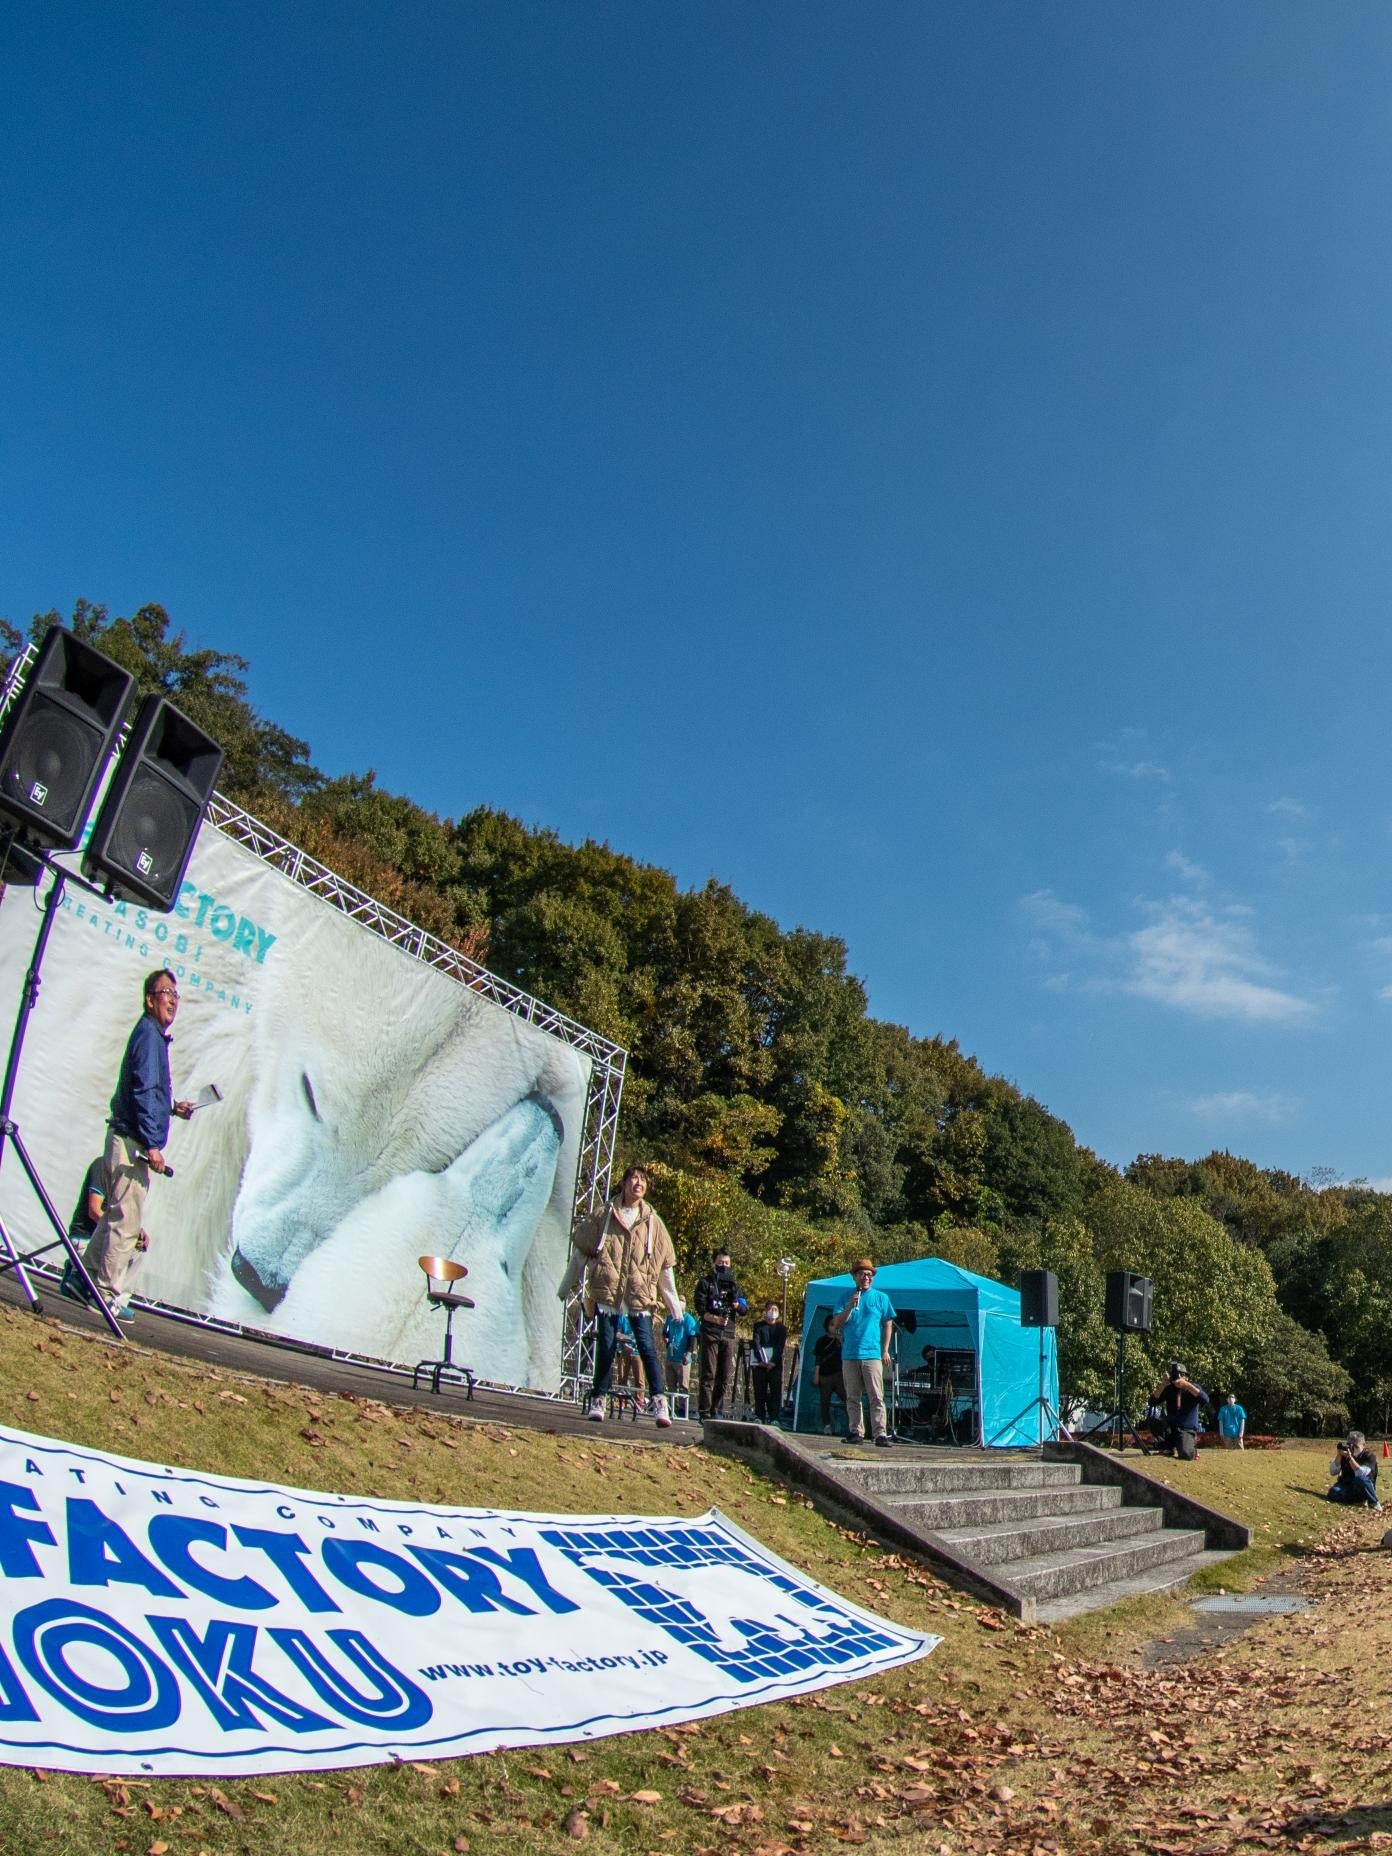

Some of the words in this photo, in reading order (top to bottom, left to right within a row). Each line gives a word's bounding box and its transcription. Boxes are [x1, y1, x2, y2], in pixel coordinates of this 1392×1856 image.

[62, 895, 149, 957] REATING
[276, 1505, 518, 1540] COMPANY
[0, 1480, 582, 1617] FACTORY
[417, 1649, 669, 1682] www.toy-factory.jp
